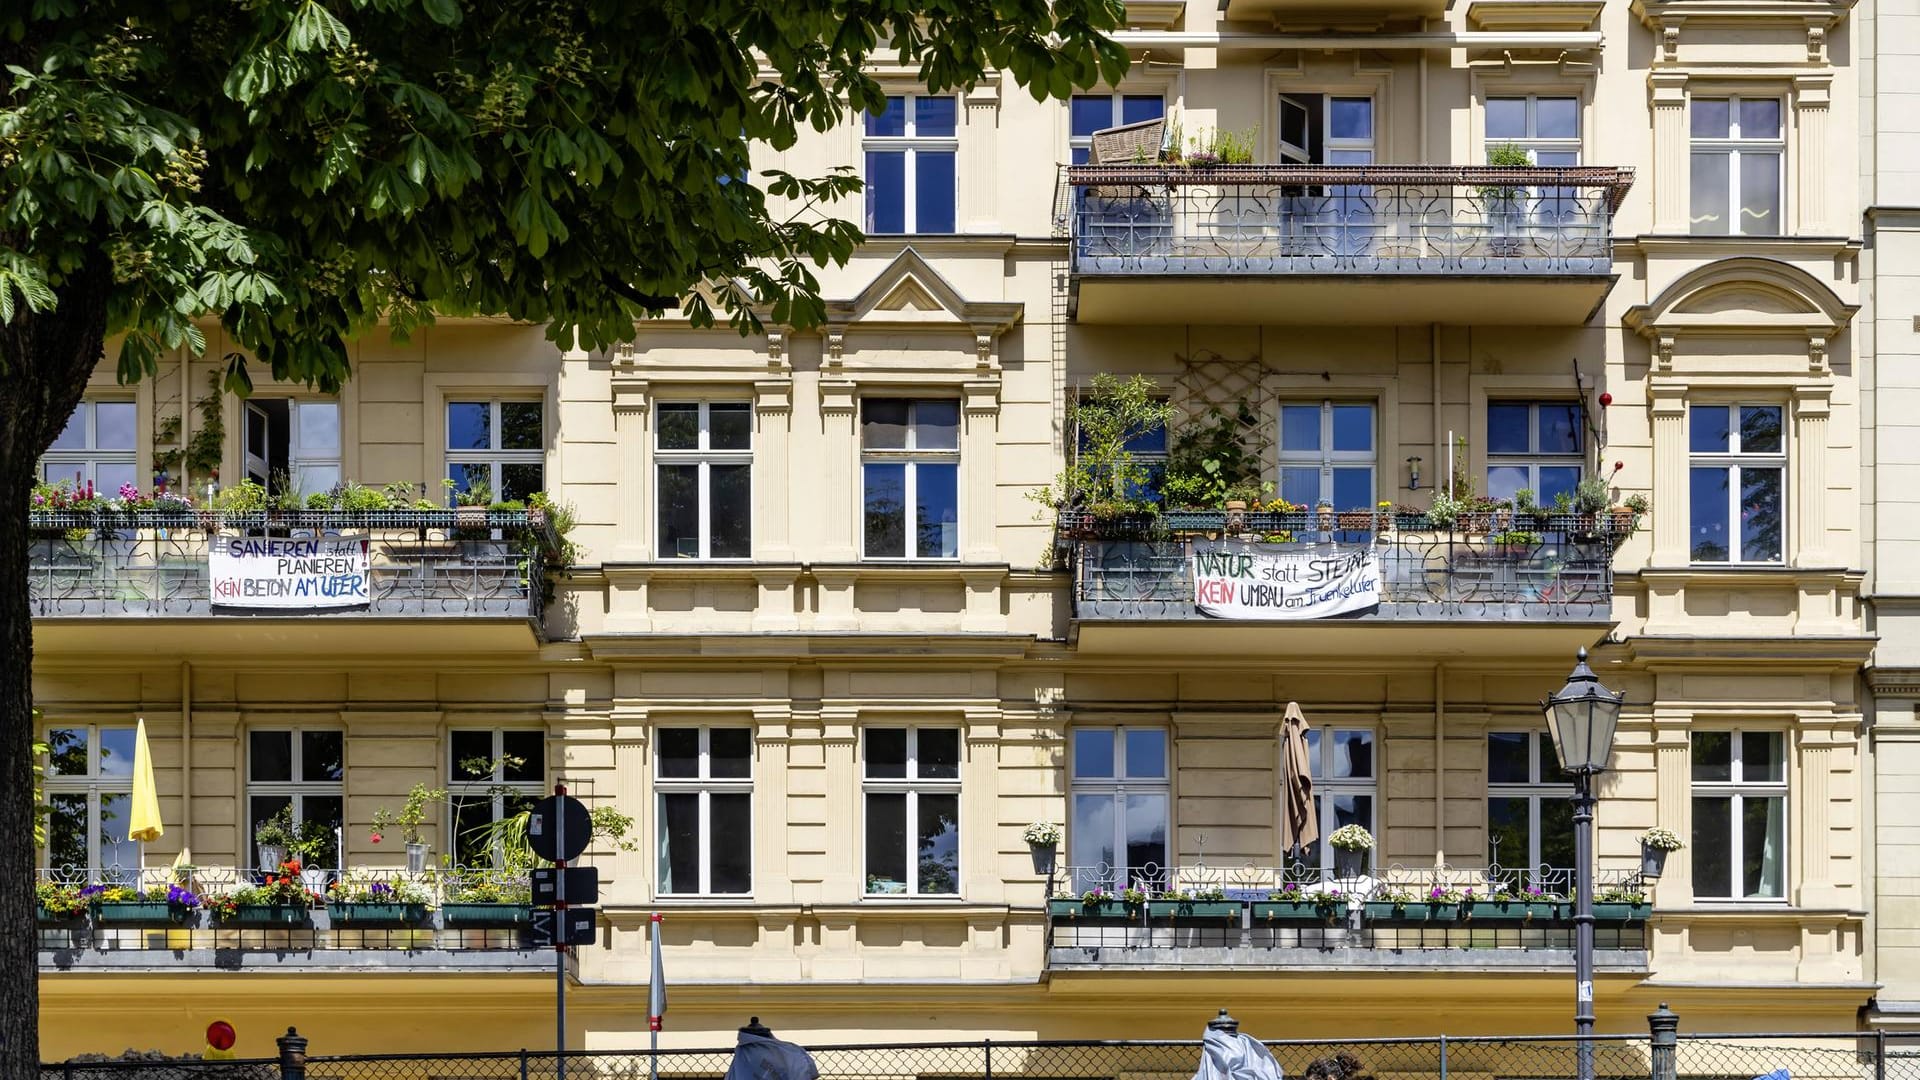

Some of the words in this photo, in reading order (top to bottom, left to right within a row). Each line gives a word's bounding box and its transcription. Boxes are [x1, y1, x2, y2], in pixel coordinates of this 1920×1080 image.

[230, 539, 318, 558] SANIEREN
[327, 541, 356, 556] statt
[278, 559, 354, 575] PLANIEREN
[1197, 551, 1255, 579] NATUR
[1263, 563, 1299, 582] statt
[1308, 552, 1371, 581] STEINE
[244, 578, 291, 596] BETON
[295, 577, 318, 596] AM
[1241, 585, 1283, 607] UMBAU
[1285, 597, 1303, 607] am
